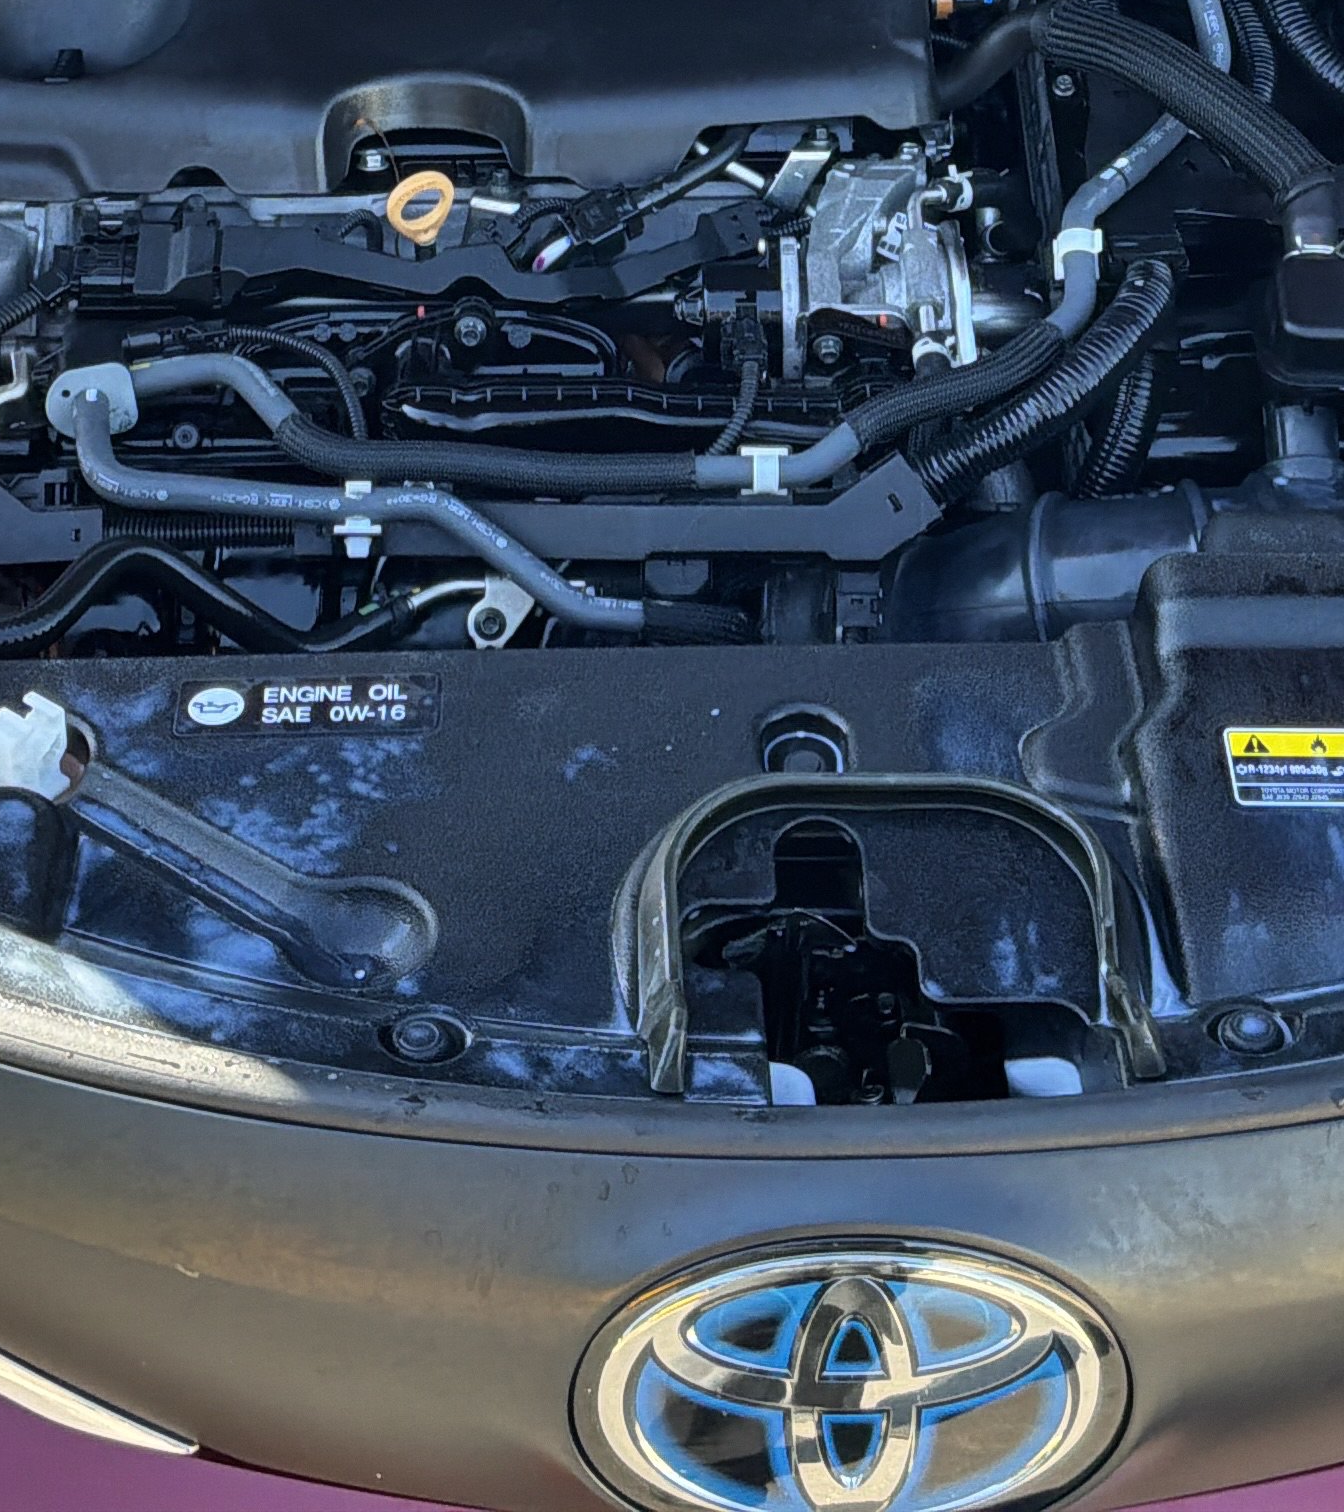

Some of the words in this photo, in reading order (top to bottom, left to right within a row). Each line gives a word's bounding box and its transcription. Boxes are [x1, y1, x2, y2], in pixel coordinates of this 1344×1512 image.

[263, 685, 352, 703] ENGINE
[368, 684, 407, 701] OIL
[261, 706, 311, 724] SAE
[329, 704, 406, 722] 0W-16
